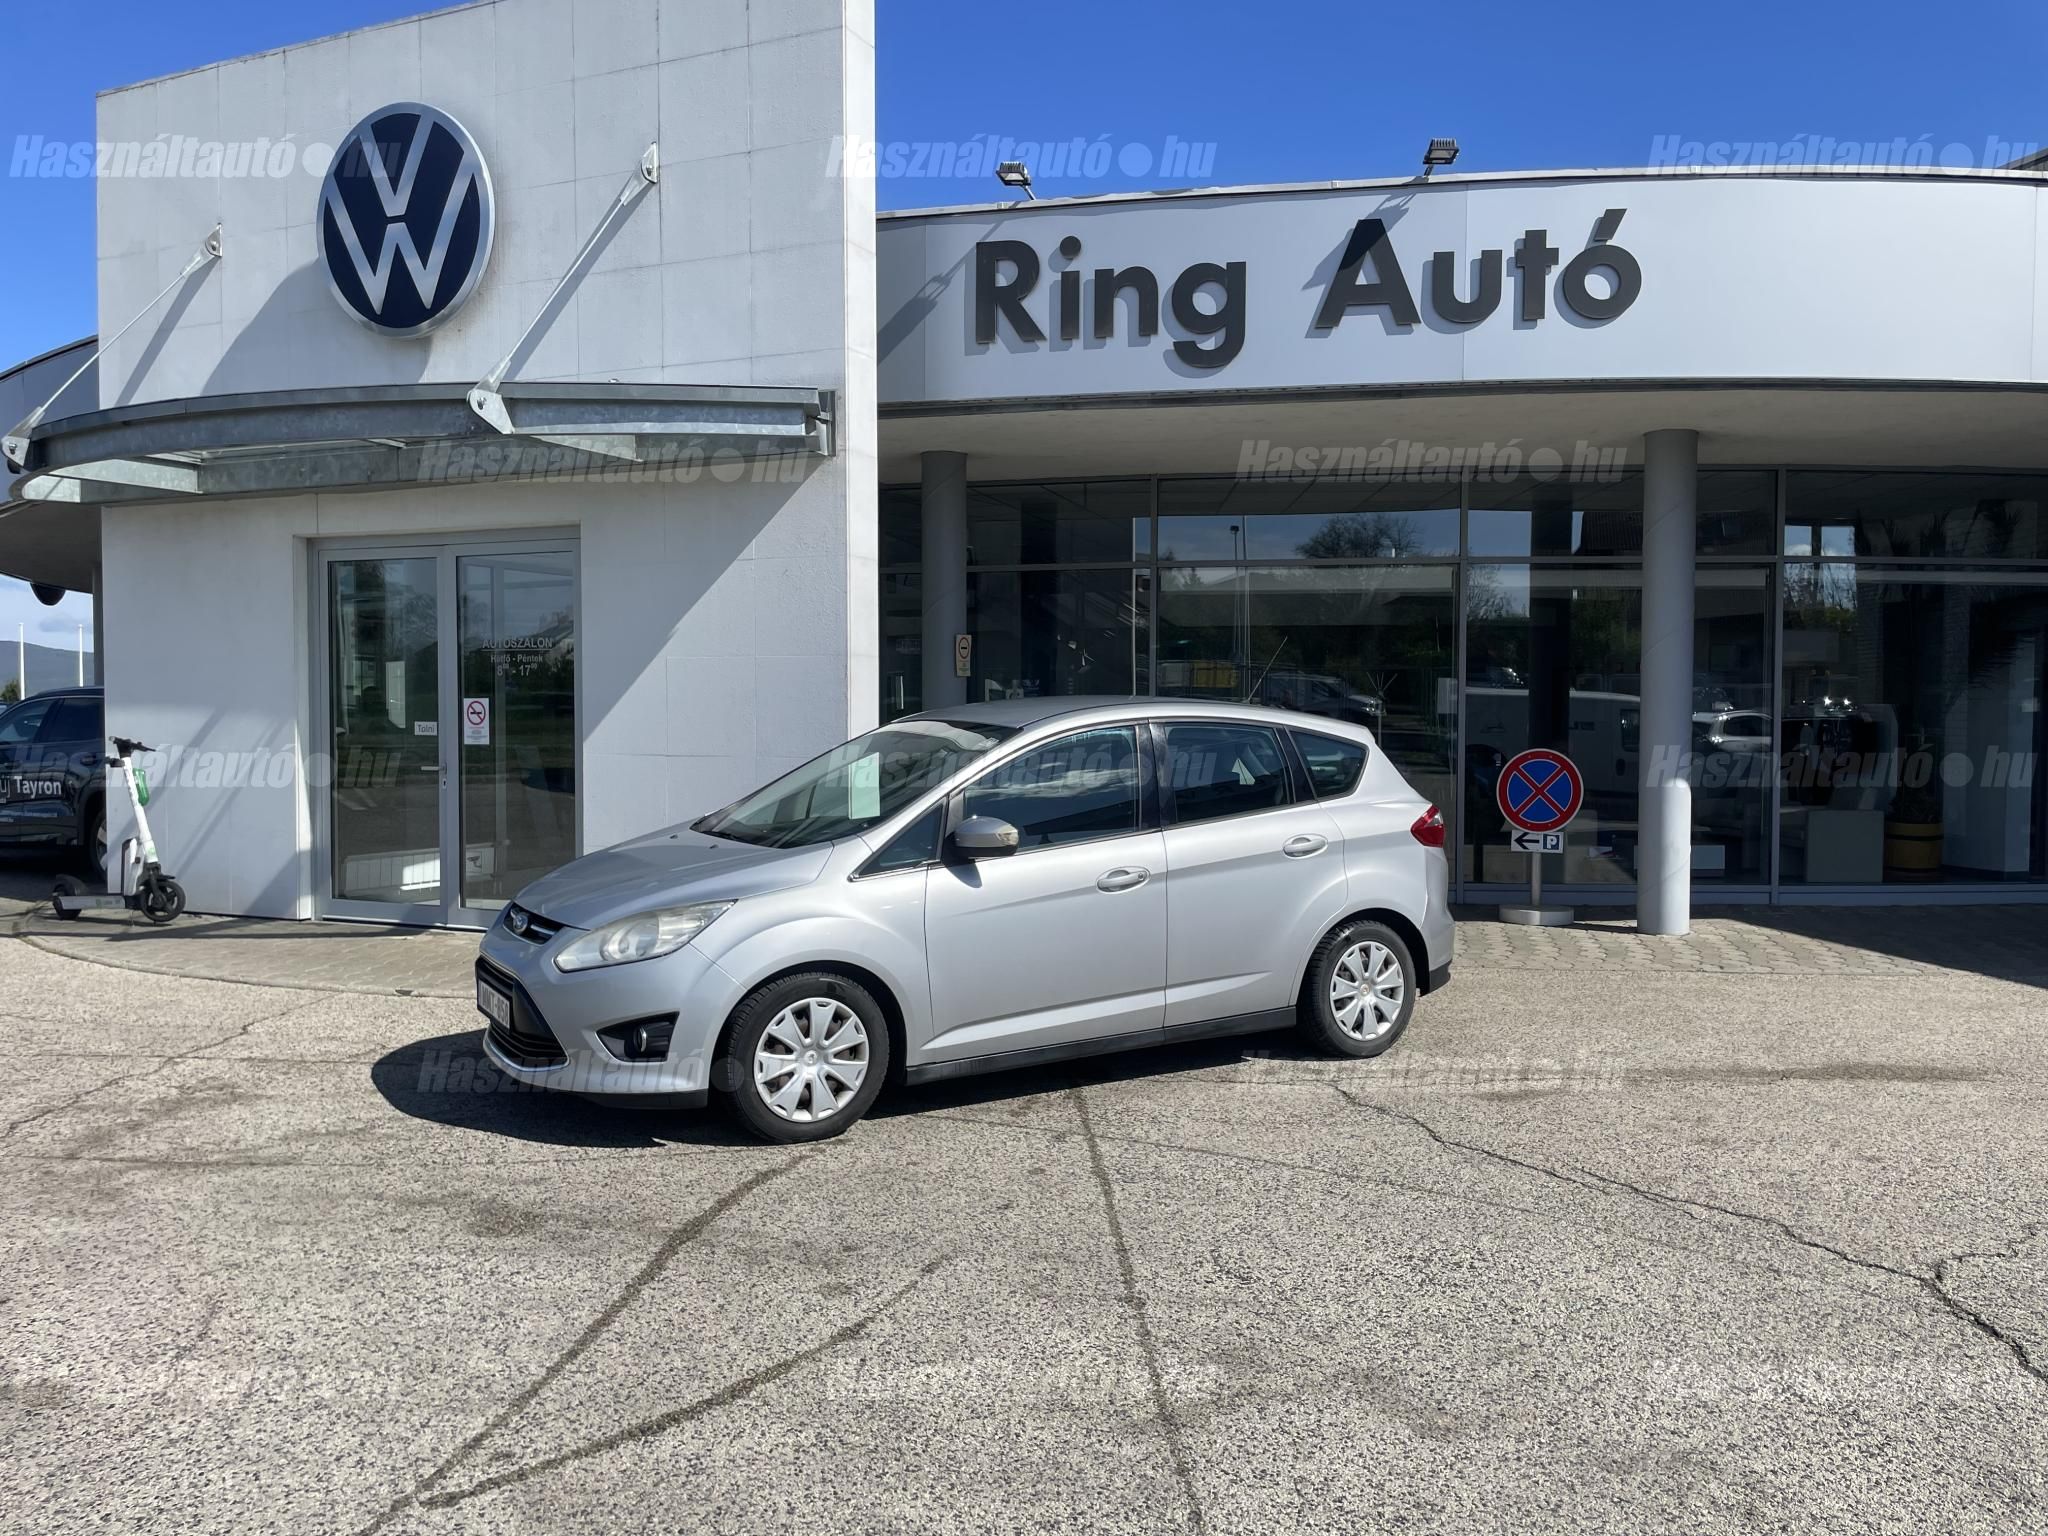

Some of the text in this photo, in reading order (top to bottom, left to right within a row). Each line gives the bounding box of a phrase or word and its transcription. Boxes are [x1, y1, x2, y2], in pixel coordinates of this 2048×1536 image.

[975, 208, 1642, 369] Ring Autó
[418, 724, 435, 733] Tolni
[14, 775, 62, 799] Tayron
[1546, 835, 1558, 849] P
